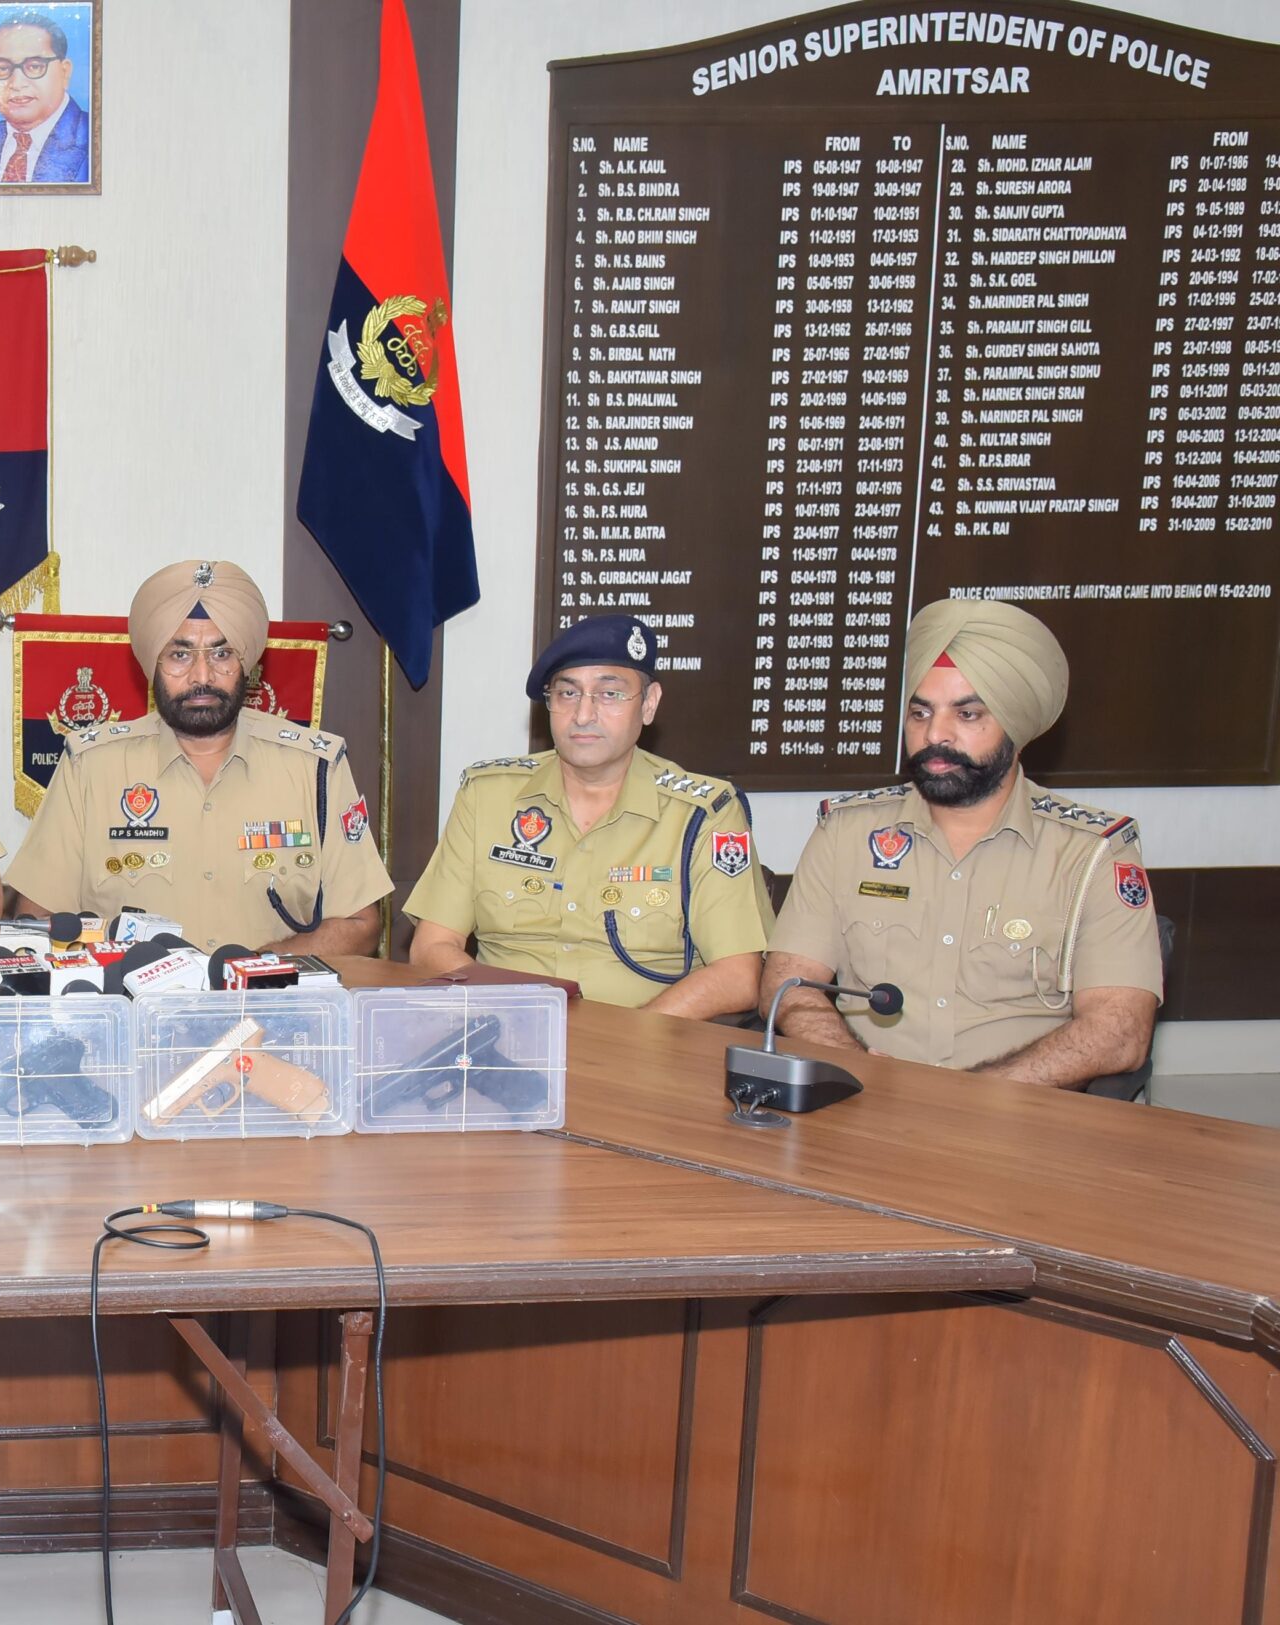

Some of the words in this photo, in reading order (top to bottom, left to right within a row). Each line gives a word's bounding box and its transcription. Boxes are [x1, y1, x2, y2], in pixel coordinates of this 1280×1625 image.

[692, 39, 798, 96] SENIOR
[804, 12, 1064, 62] SUPERINTENDENT
[1068, 27, 1106, 57] OF
[1110, 35, 1209, 89] POLICE
[876, 67, 1029, 95] AMRITSAR
[614, 137, 648, 152] NAME
[826, 137, 860, 151] FROM
[893, 136, 911, 150] TO
[992, 135, 1027, 149] NAME
[1213, 132, 1248, 146] FROM
[580, 161, 587, 174] 1.
[599, 160, 614, 174] Sh.
[639, 160, 666, 173] KAUL
[784, 160, 802, 174] IPS
[814, 160, 861, 174] 05-08-1947
[876, 159, 923, 173] 18-08-1947
[952, 159, 966, 172] 28.
[978, 159, 994, 172] Sh.
[1031, 158, 1062, 171] IZHAR
[1064, 157, 1092, 171] ALAM
[1171, 156, 1188, 169] IPS
[1200, 155, 1248, 169] 01-07-1986
[578, 183, 587, 197] 2.
[598, 183, 615, 197] Sh.
[639, 183, 679, 196] BINDRA
[783, 182, 800, 196] IPS
[813, 183, 859, 196] 19-08-1947
[874, 183, 921, 196] 30-09-1947
[576, 231, 585, 244] 4.
[596, 230, 612, 244] Sh.
[615, 230, 635, 244] RAO
[638, 230, 663, 244] BHIM
[665, 230, 697, 244] SINGH
[780, 230, 798, 244] IPS
[810, 230, 855, 243] 11-02-1951
[873, 229, 918, 242] 17-03-1953
[947, 229, 961, 242] 31.
[973, 228, 989, 242] Sh.
[992, 228, 1041, 241] SIDARATH
[1043, 227, 1126, 241] CHATTOPADHAYA
[1165, 225, 1182, 238] IPS
[1193, 225, 1242, 238] 04-12-1991
[573, 324, 582, 338] 8.
[590, 324, 607, 338] Sh.
[774, 324, 791, 338] IPS
[805, 323, 850, 337] 13-12-1962
[865, 323, 911, 336] 26-07-1966
[939, 345, 953, 358] 36.
[966, 345, 982, 358] Sh.
[985, 344, 1025, 358] GURDEV
[1027, 343, 1058, 357] SINGH
[1061, 342, 1100, 356] SAHOTA
[1154, 342, 1171, 355] IPS
[1183, 341, 1231, 354] 23-07-1998
[566, 416, 580, 429] 12.
[587, 416, 602, 429] Sh.
[606, 416, 660, 429] BARJINDER
[662, 416, 693, 429] SINGH
[769, 416, 787, 429] IPS
[800, 416, 845, 429] 16-06-1969
[859, 416, 905, 429] 24-06-1971
[565, 483, 579, 496] 15.
[584, 483, 600, 496] Sh.
[624, 482, 645, 495] JEJI
[766, 481, 783, 494] IPS
[797, 482, 841, 495] 17-11-1973
[856, 482, 902, 495] 08-07-1976
[929, 502, 943, 515] 43.
[956, 501, 971, 514] Sh.
[975, 501, 1017, 514] KUNWAR
[1020, 500, 1047, 513] VIJAY
[1049, 499, 1086, 512] PRATAP
[1088, 499, 1119, 512] SINGH
[1141, 496, 1158, 509] IPS
[1171, 495, 1218, 508] 18-04-2007
[1228, 495, 1275, 508] 31-10-2009
[927, 524, 941, 536] 44.
[955, 523, 970, 536] Sh.
[993, 522, 1009, 535] RAI
[1140, 518, 1157, 531] IPS
[1168, 518, 1215, 531] 31-10-2009
[1225, 517, 1272, 530] 15-02-2010
[561, 593, 575, 606] 20.
[579, 593, 595, 606] Sh.
[618, 593, 651, 605] ATWAL
[759, 591, 776, 604] IPS
[790, 592, 834, 605] 12-09-1981
[848, 592, 892, 605] 16-04-1982
[949, 587, 982, 601] POLICE
[984, 586, 1070, 601] COMMISSIONERATE
[1074, 585, 1122, 599] AMRITSAR
[1124, 585, 1149, 598] CAME
[1151, 585, 1172, 598] INTO
[1175, 585, 1202, 598] BEING
[1204, 584, 1217, 597] ON
[1220, 585, 1271, 597] 15-02-2010
[32, 753, 59, 766] POLICE
